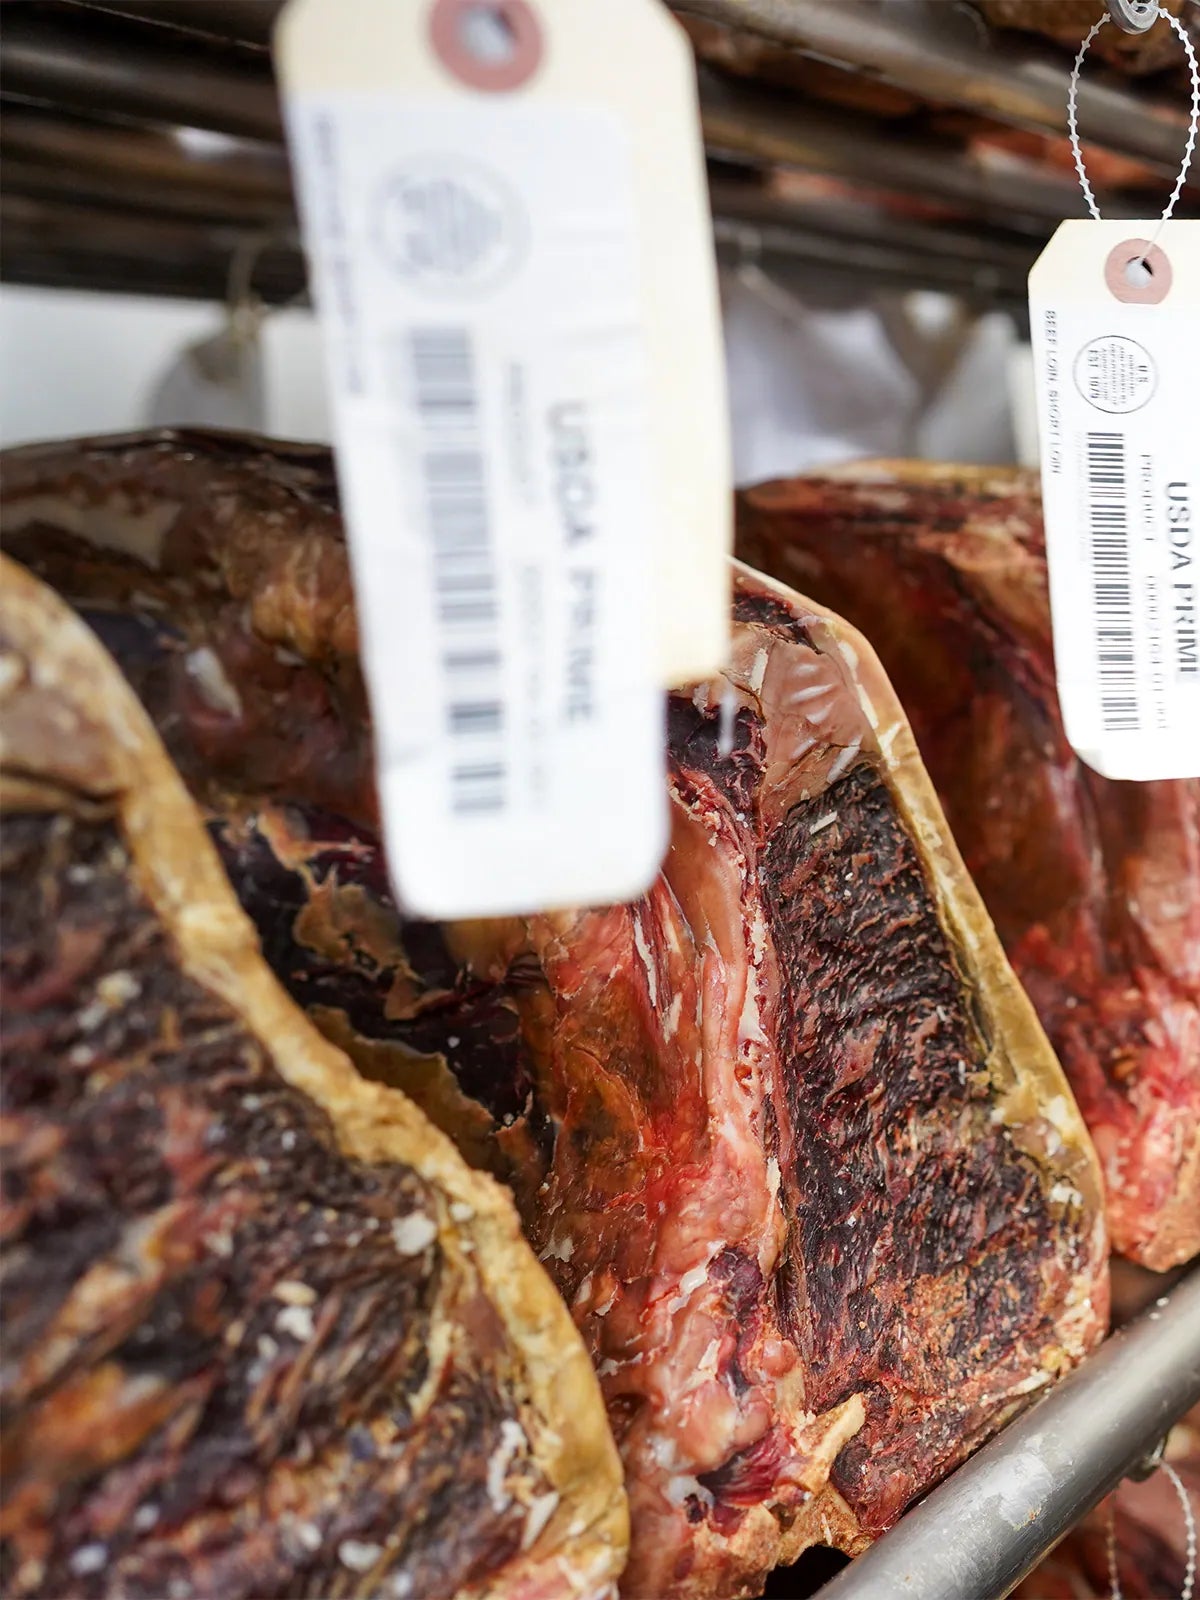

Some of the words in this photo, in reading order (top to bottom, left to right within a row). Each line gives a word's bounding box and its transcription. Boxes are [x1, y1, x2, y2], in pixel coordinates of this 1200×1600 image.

[1045, 310, 1057, 345] BEEF
[1047, 389, 1061, 436] SHORT
[1140, 454, 1157, 541] PRODUCT
[1164, 481, 1194, 571] USDA
